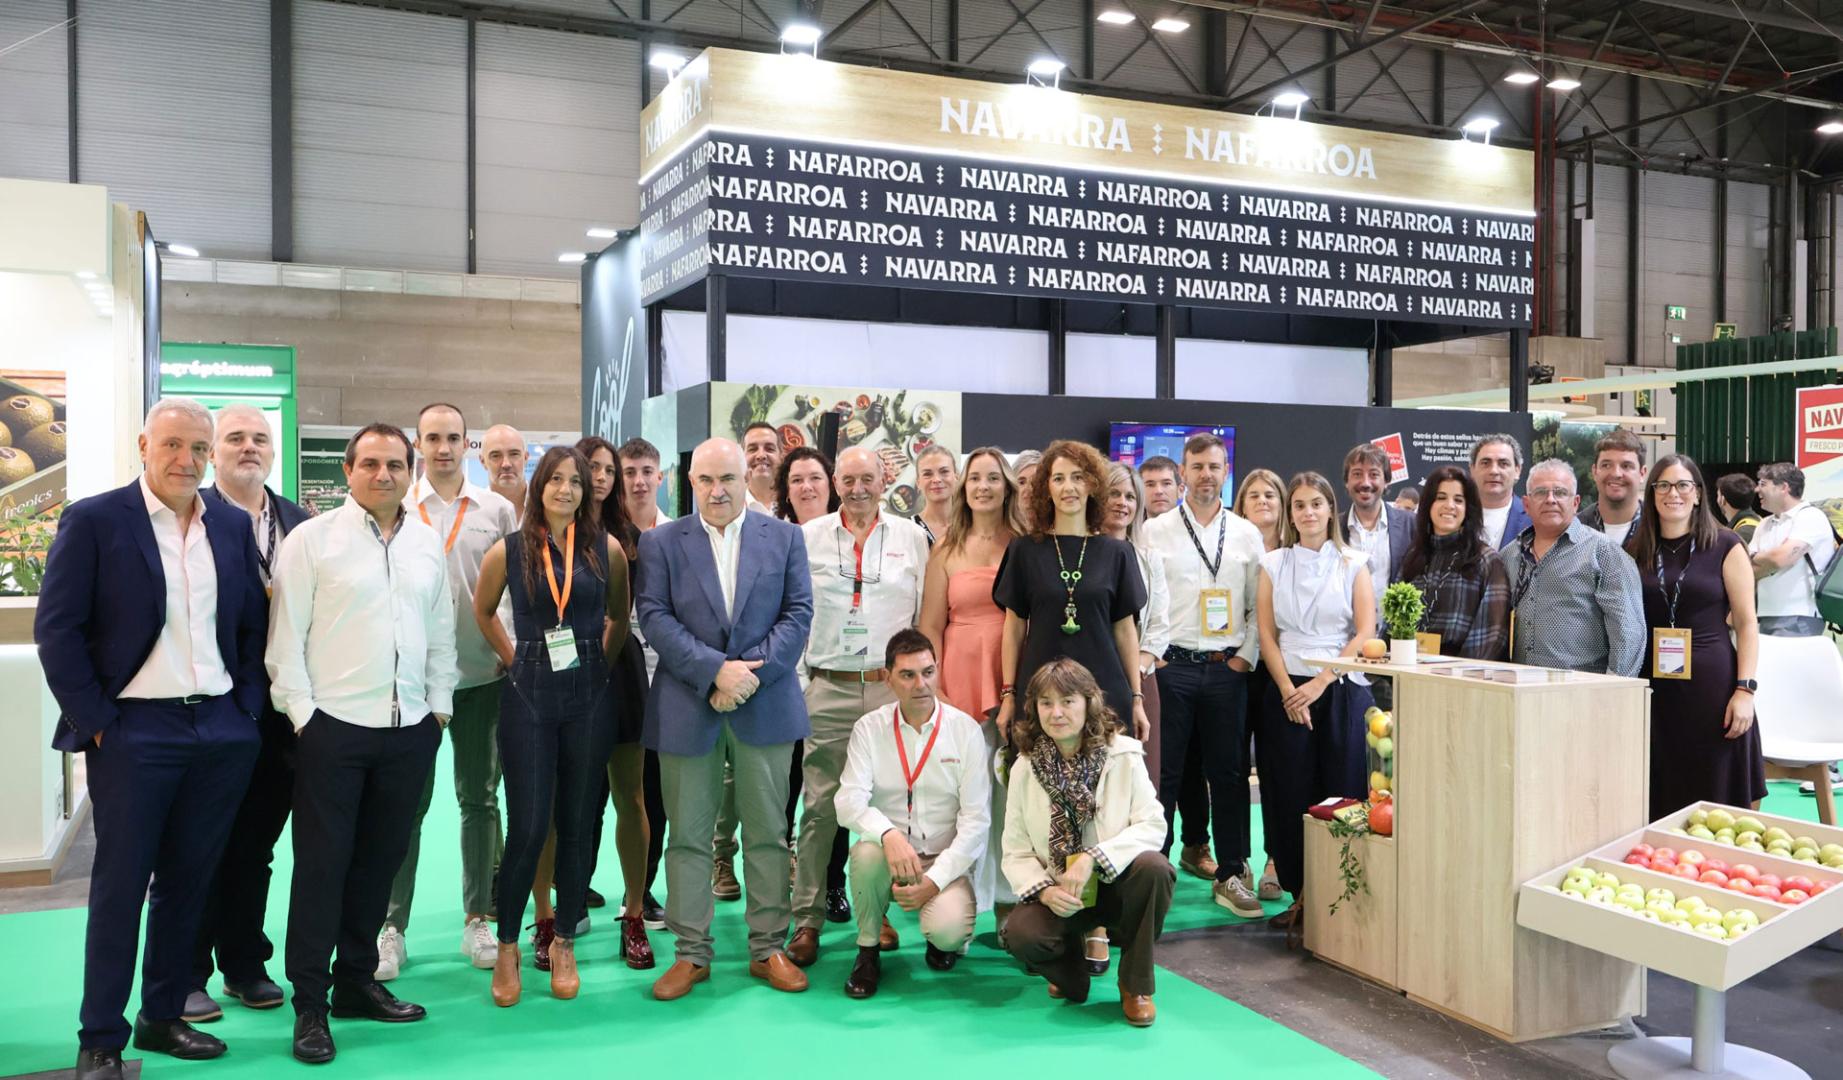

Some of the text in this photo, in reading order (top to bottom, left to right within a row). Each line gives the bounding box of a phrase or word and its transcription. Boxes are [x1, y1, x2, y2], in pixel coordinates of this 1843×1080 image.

[939, 96, 1133, 153] NAVARRA
[653, 161, 683, 203] NAVARRA
[788, 149, 925, 184] NAFARROA
[961, 167, 1069, 198] NAVARRA
[1097, 181, 1213, 211] NAFARROA
[1240, 196, 1332, 223] NAVARRA
[1356, 207, 1454, 235] NAFARROA
[788, 216, 924, 248] NAFARROA
[961, 231, 1068, 259] NAVARRA
[1097, 242, 1212, 270] NAFARROA
[1239, 254, 1331, 279] NAVARRA
[1356, 263, 1454, 289] NAFARROA
[885, 192, 998, 222] NAVARRA
[1028, 205, 1148, 235] NAFARROA
[1176, 218, 1272, 246] NAVARRA
[1297, 230, 1399, 257] NAFARROA
[1421, 242, 1504, 266] NAVARRA
[885, 256, 998, 285] NAVARRA
[1028, 267, 1147, 295] NAFARROA
[1176, 277, 1271, 304] NAVARRA
[1297, 287, 1399, 312] NAFARROA
[1421, 296, 1503, 320] NAVARRA
[1810, 441, 1836, 450] FRESCO
